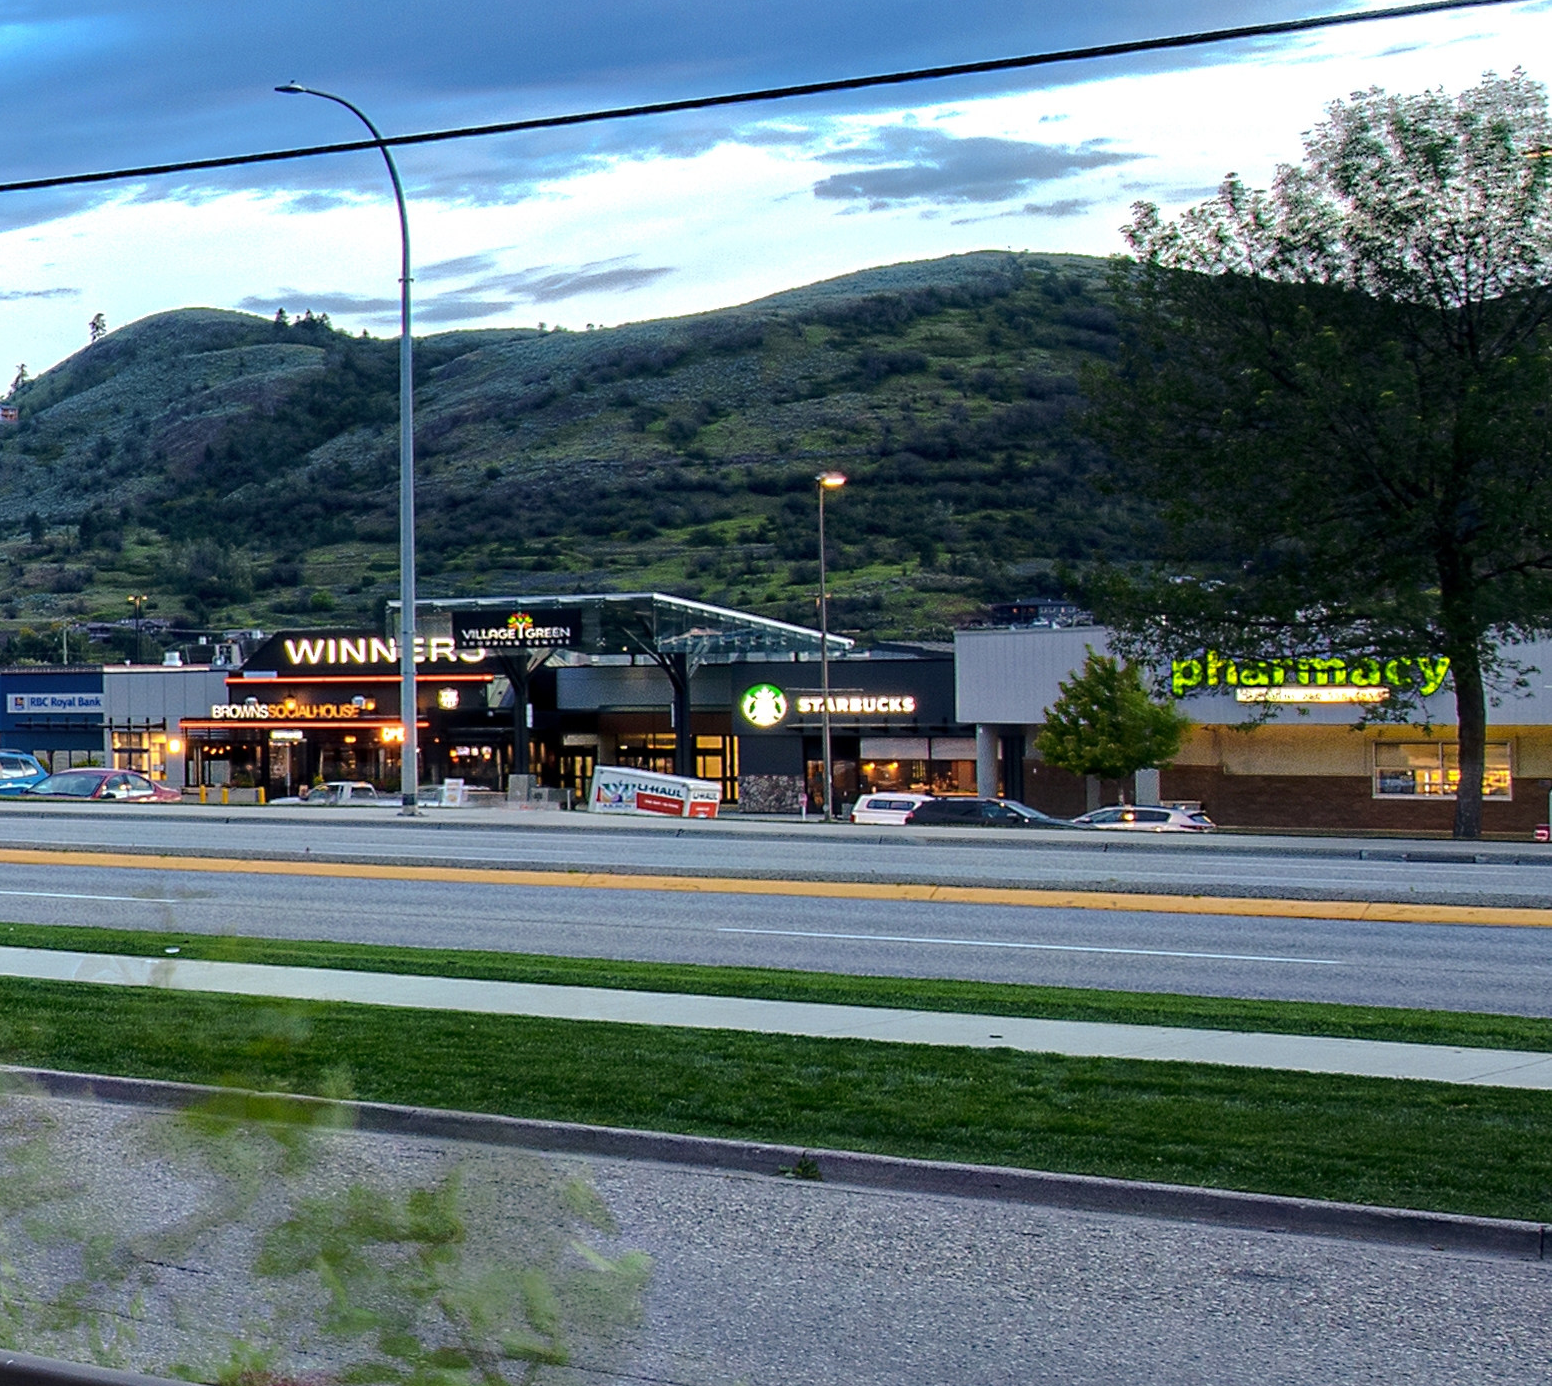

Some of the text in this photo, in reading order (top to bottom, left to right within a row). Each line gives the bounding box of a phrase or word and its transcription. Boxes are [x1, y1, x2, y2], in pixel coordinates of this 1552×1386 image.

[461, 626, 571, 640] VILLAGE GREEN
[1171, 649, 1451, 698] pharmacy
[30, 696, 102, 709] RBC Royal Bank
[797, 695, 916, 714] STARBUCKS
[211, 703, 360, 719] BROWNS SOCIALHOUSE
